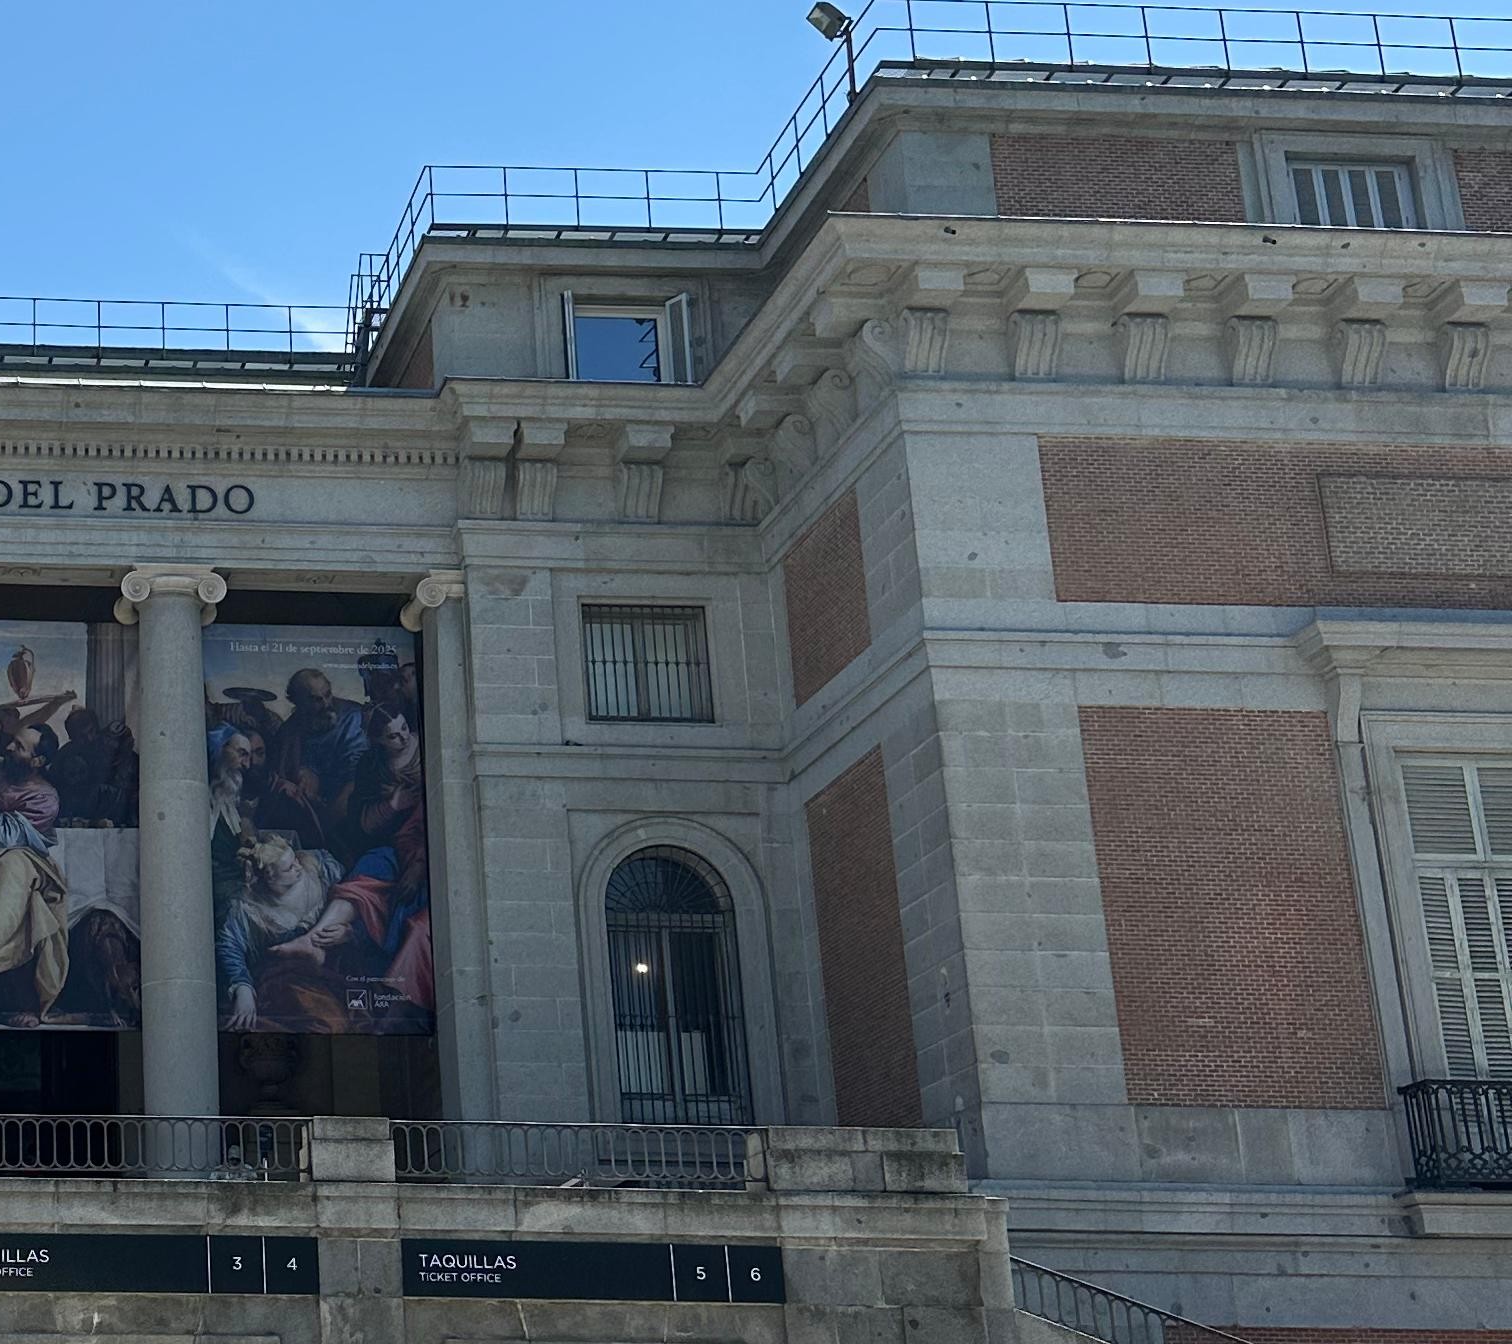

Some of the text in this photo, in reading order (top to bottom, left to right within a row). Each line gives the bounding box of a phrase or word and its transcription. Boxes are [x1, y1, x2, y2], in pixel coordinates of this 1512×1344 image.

[92, 482, 255, 514] PRADO
[230, 641, 259, 653] Hasta
[260, 641, 270, 653] el
[271, 642, 283, 653] 21
[285, 642, 298, 653] de
[299, 642, 355, 656] septiembre
[356, 643, 370, 655] de
[232, 1256, 243, 1271] 3
[286, 1257, 298, 1271] 4
[418, 1253, 517, 1270] TAQUILLAS
[418, 1271, 502, 1283] TICKET OFFICE
[696, 1266, 707, 1280] 5
[750, 1267, 762, 1282] 6
